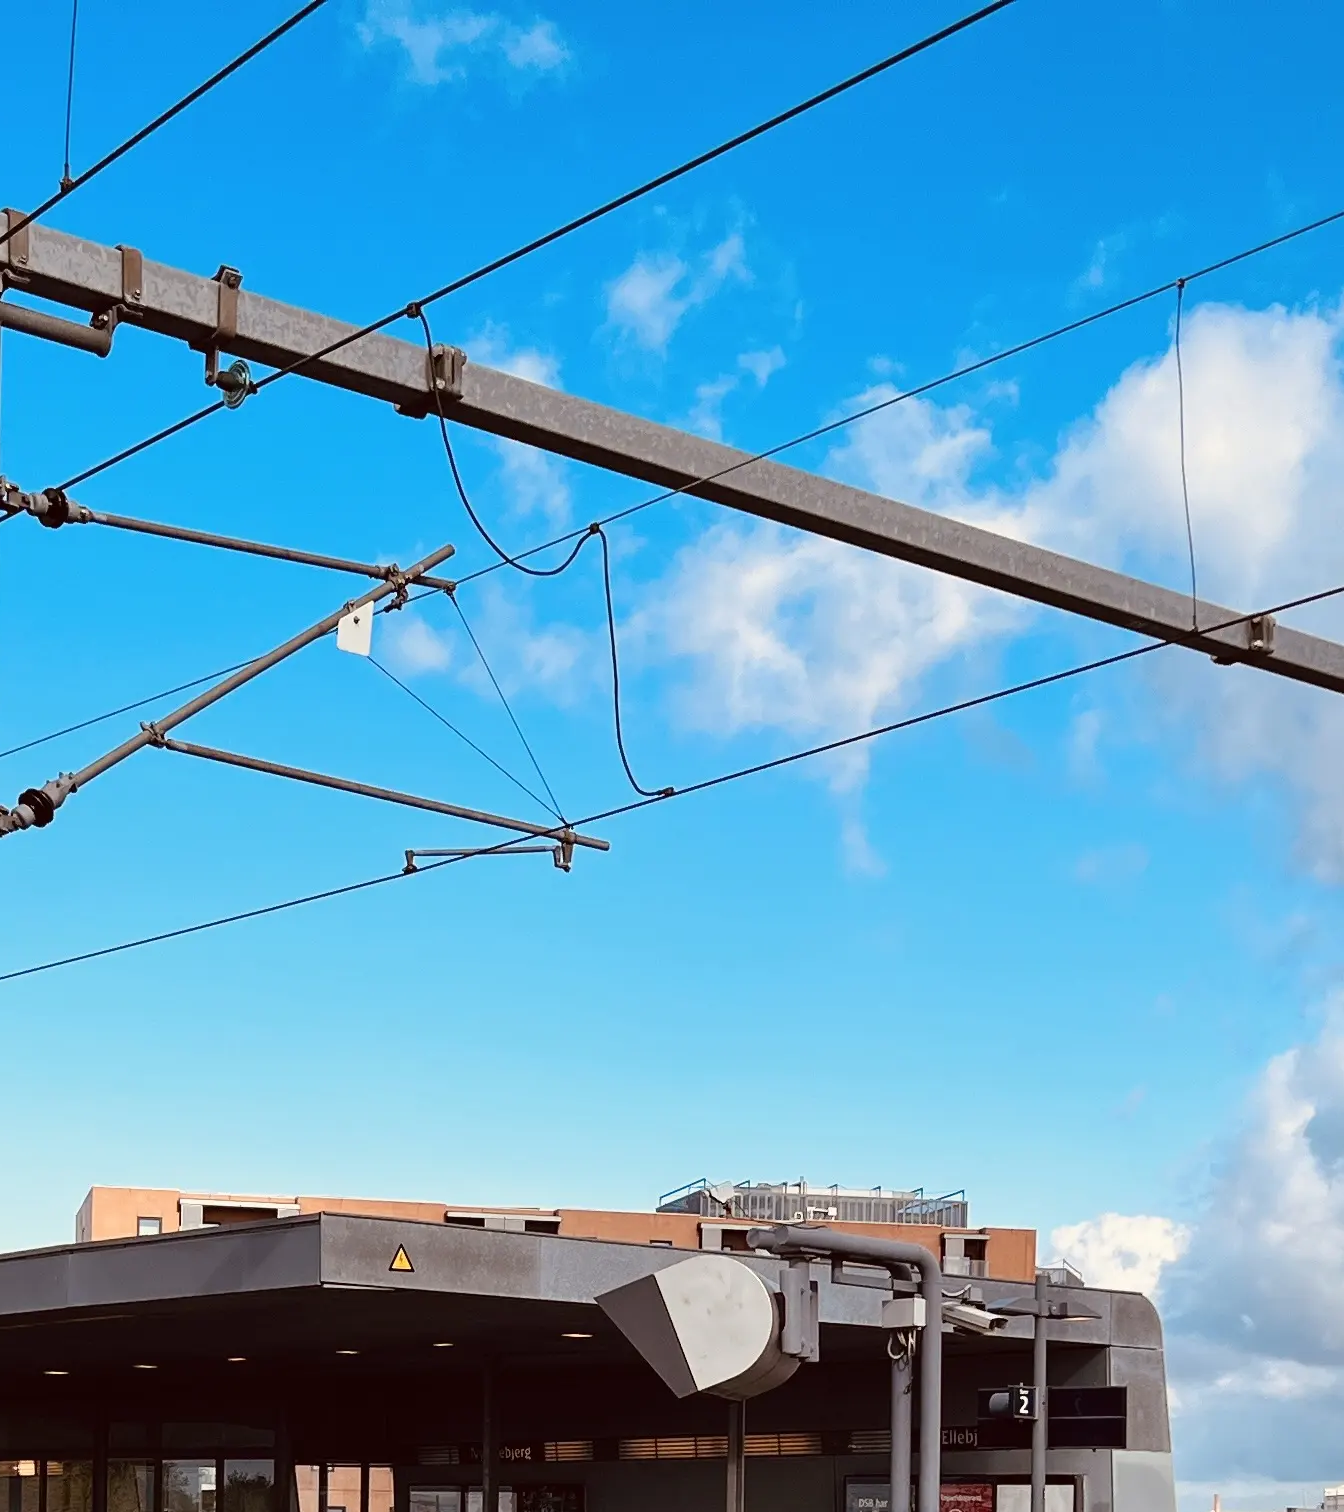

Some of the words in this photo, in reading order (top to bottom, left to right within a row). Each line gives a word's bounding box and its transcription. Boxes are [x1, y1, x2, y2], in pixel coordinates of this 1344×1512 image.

[1019, 1396, 1029, 1414] 2
[942, 1430, 978, 1447] Ellebj
[499, 1446, 532, 1461] ebjerg
